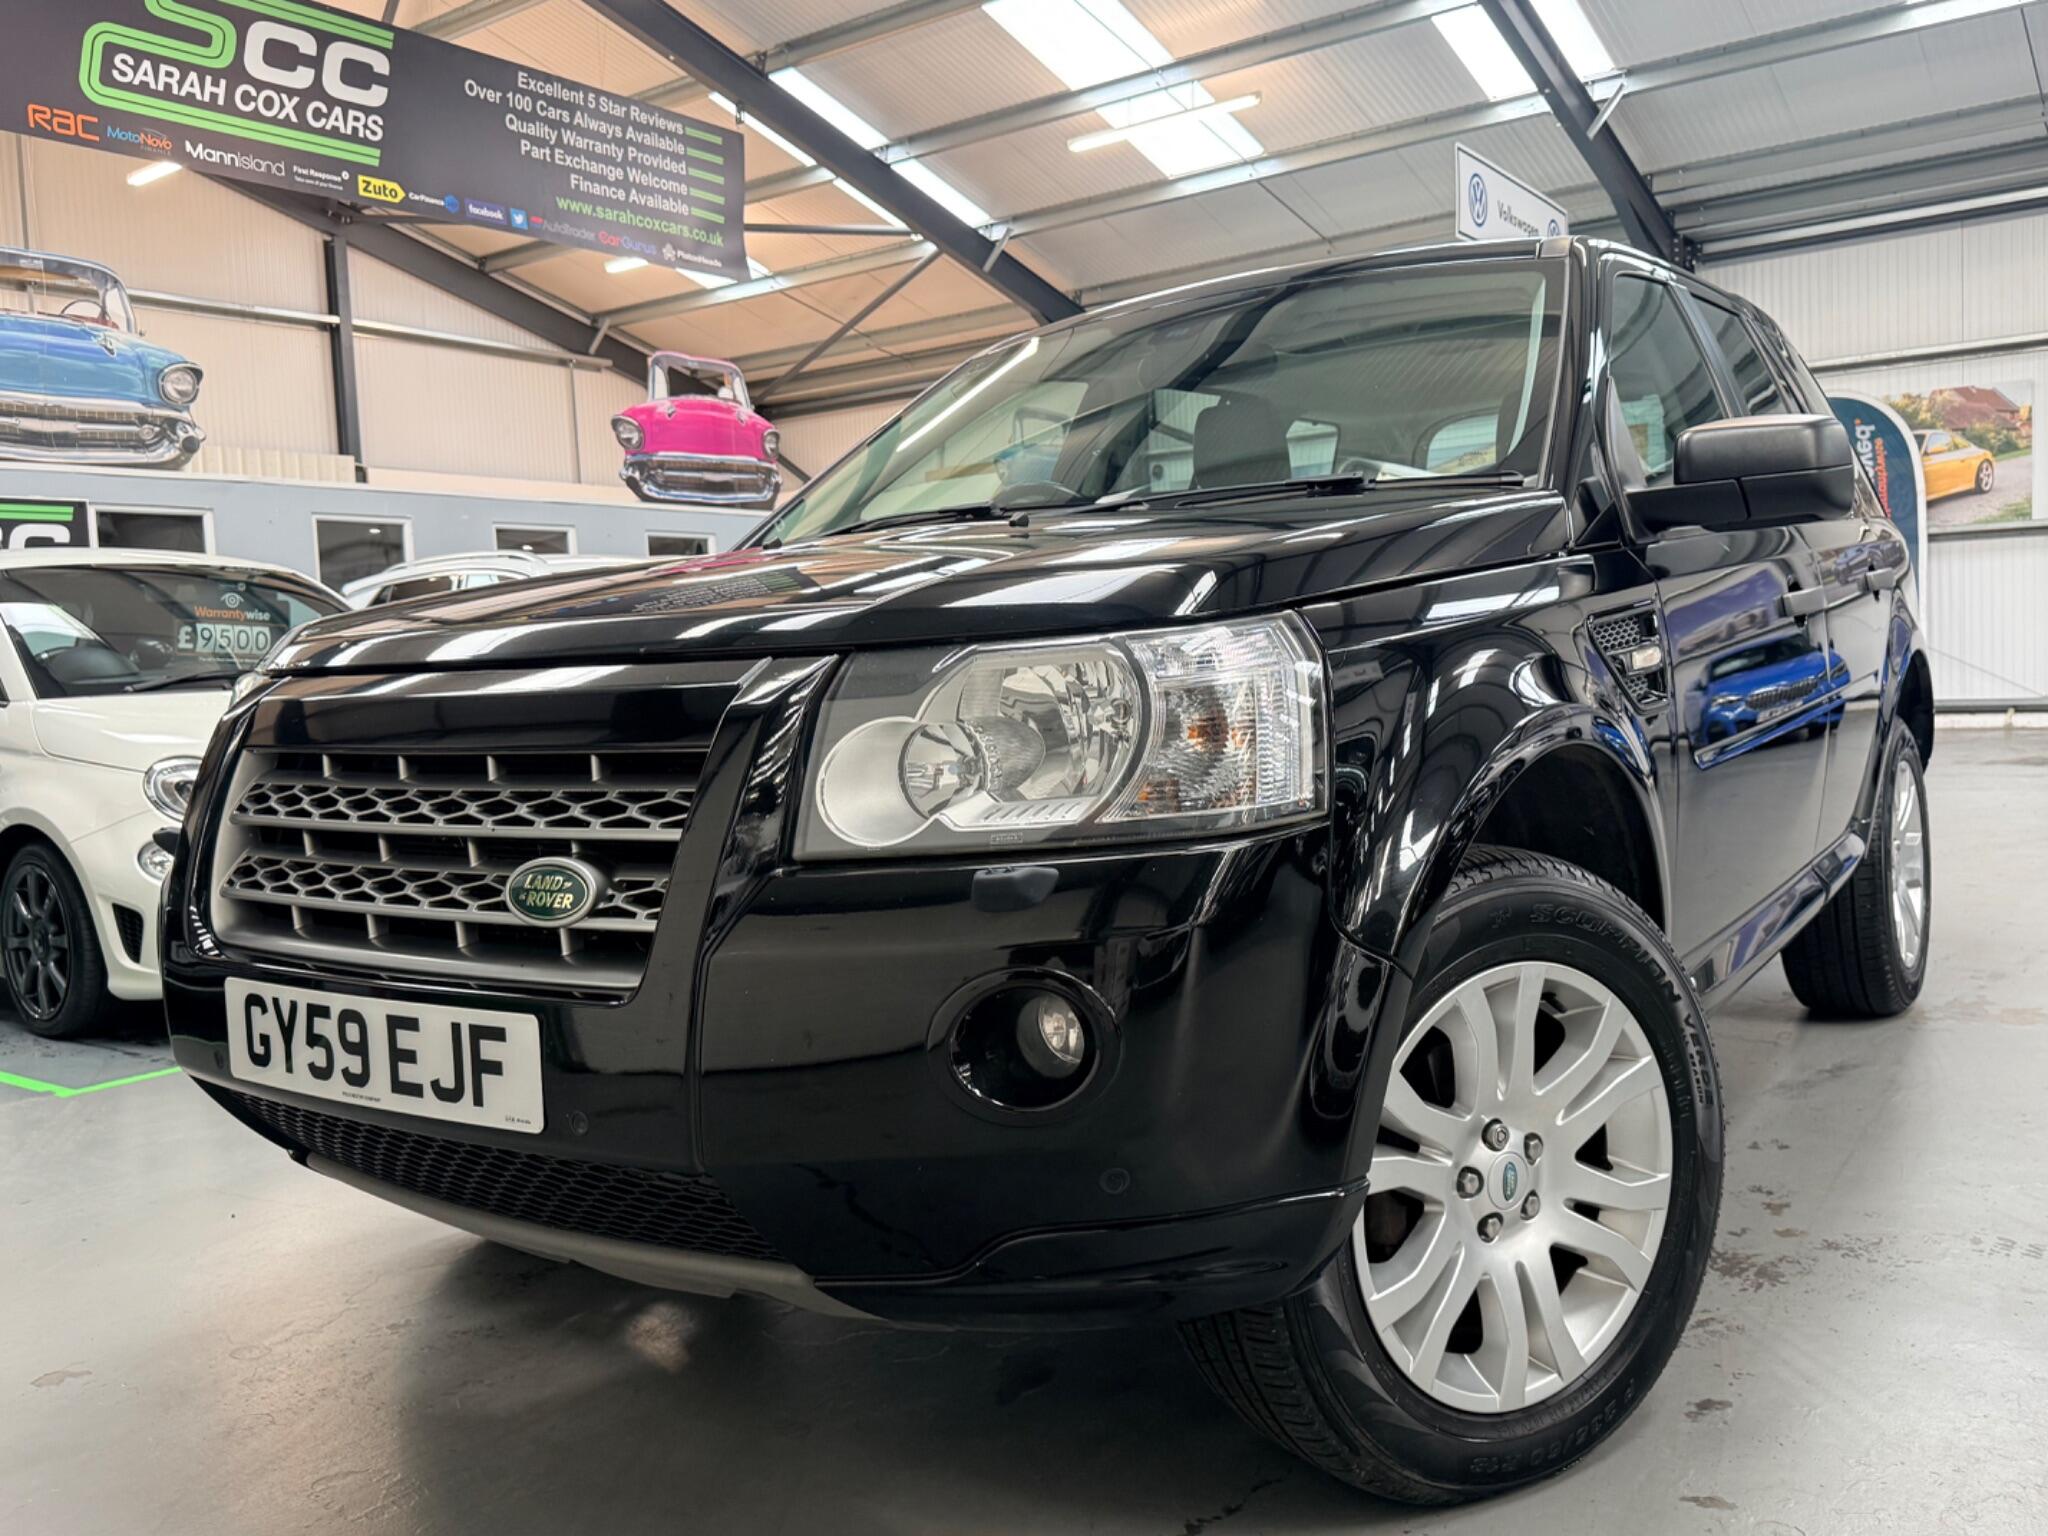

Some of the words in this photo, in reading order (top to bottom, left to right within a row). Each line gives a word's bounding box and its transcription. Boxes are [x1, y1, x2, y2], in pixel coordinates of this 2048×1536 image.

[112, 53, 228, 105] SARAH
[234, 84, 299, 122] COX
[306, 101, 384, 141] CARS
[464, 79, 502, 104] Over
[506, 92, 532, 113] 100
[536, 100, 570, 123] Cars
[573, 111, 622, 140] Always
[626, 126, 685, 155] Available
[517, 71, 585, 106] Excellent
[587, 93, 597, 109] 5
[599, 96, 628, 118] Star
[630, 107, 685, 136] Reviews
[107, 125, 172, 150] MotoNovo
[505, 114, 558, 145] Quality
[561, 128, 624, 164] Warranty
[628, 148, 687, 176] Provided
[361, 179, 398, 199] Zuto
[520, 139, 551, 163] Part
[555, 148, 624, 182] Exchange
[626, 166, 688, 196] Welcome
[468, 203, 504, 221] facebook
[570, 174, 627, 201] Finance
[629, 189, 689, 216] Available
[556, 197, 724, 248] www.sarahcoxcars.co.uk
[193, 605, 271, 622] Warrantywise
[524, 873, 564, 891] LAND
[526, 890, 575, 910] ROVER
[244, 992, 371, 1088] GY59
[385, 1013, 507, 1108] EJF
